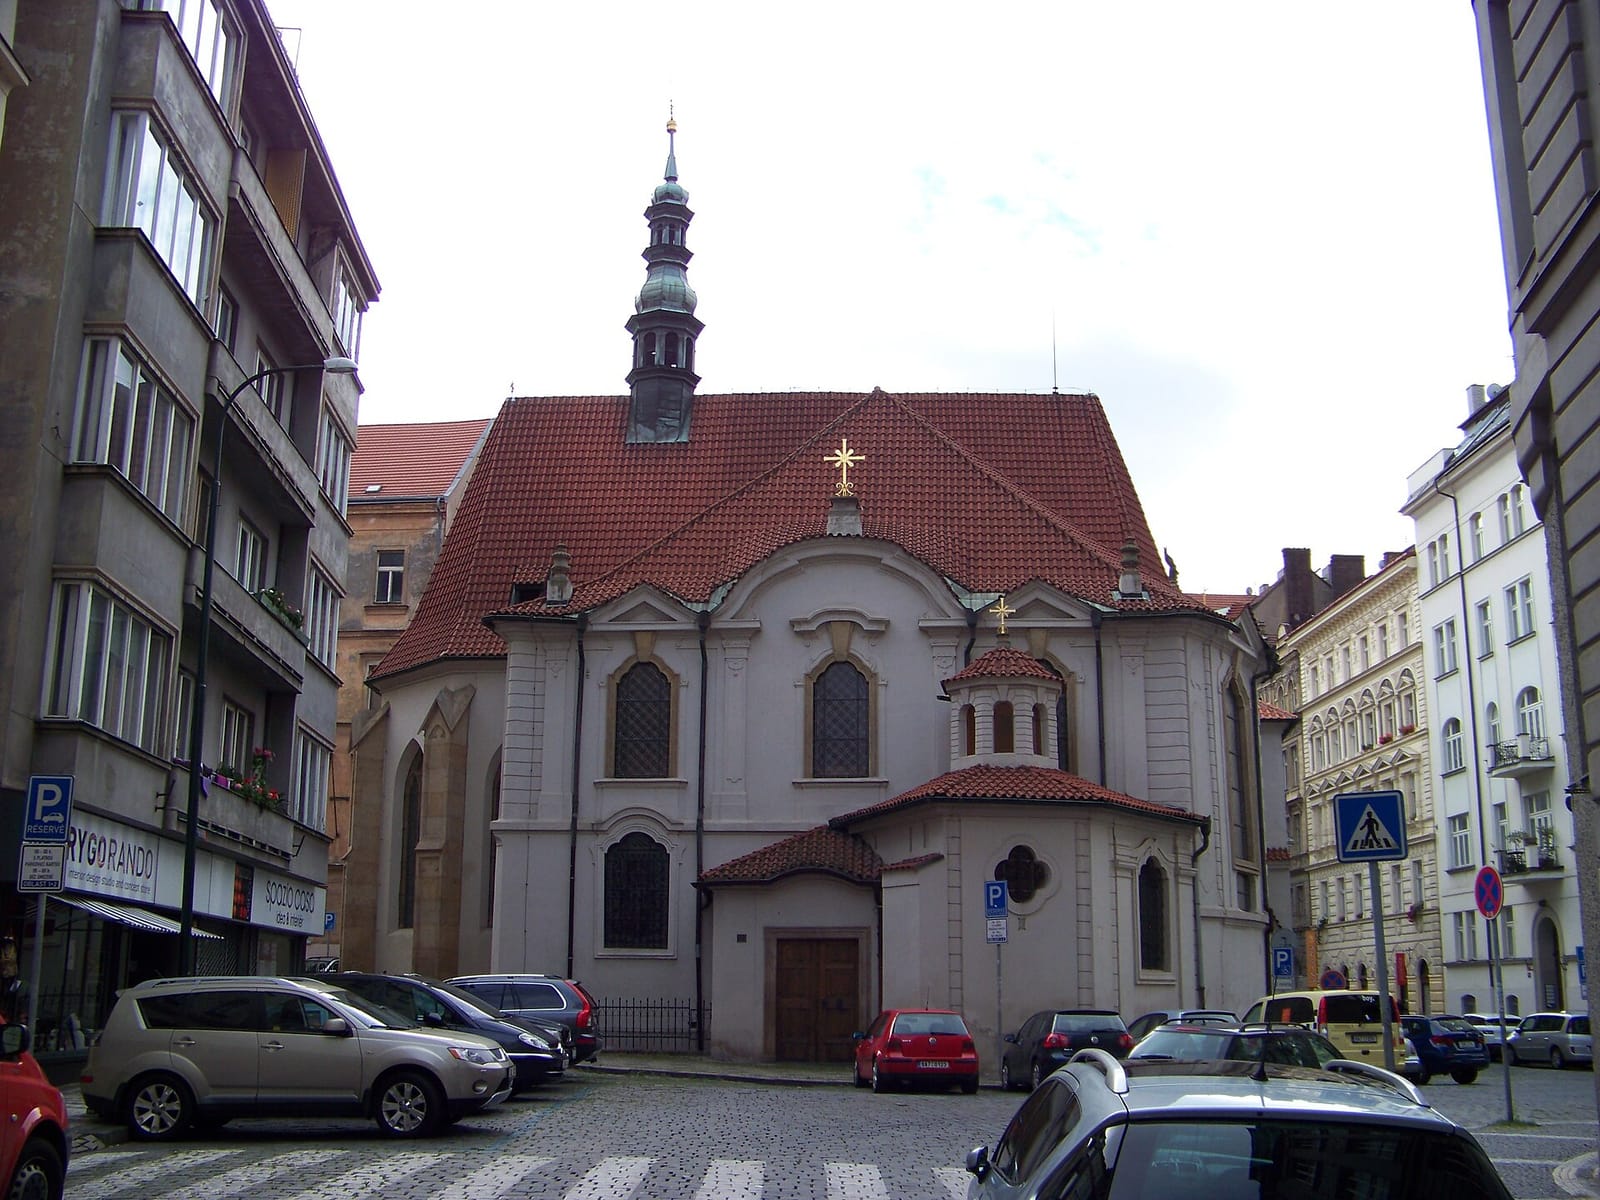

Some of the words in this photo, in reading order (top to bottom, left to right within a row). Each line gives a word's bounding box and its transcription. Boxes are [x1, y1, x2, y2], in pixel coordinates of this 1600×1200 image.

[35, 784, 62, 820] P
[990, 886, 1002, 906] P
[325, 913, 333, 925] P
[1277, 951, 1288, 969] P
